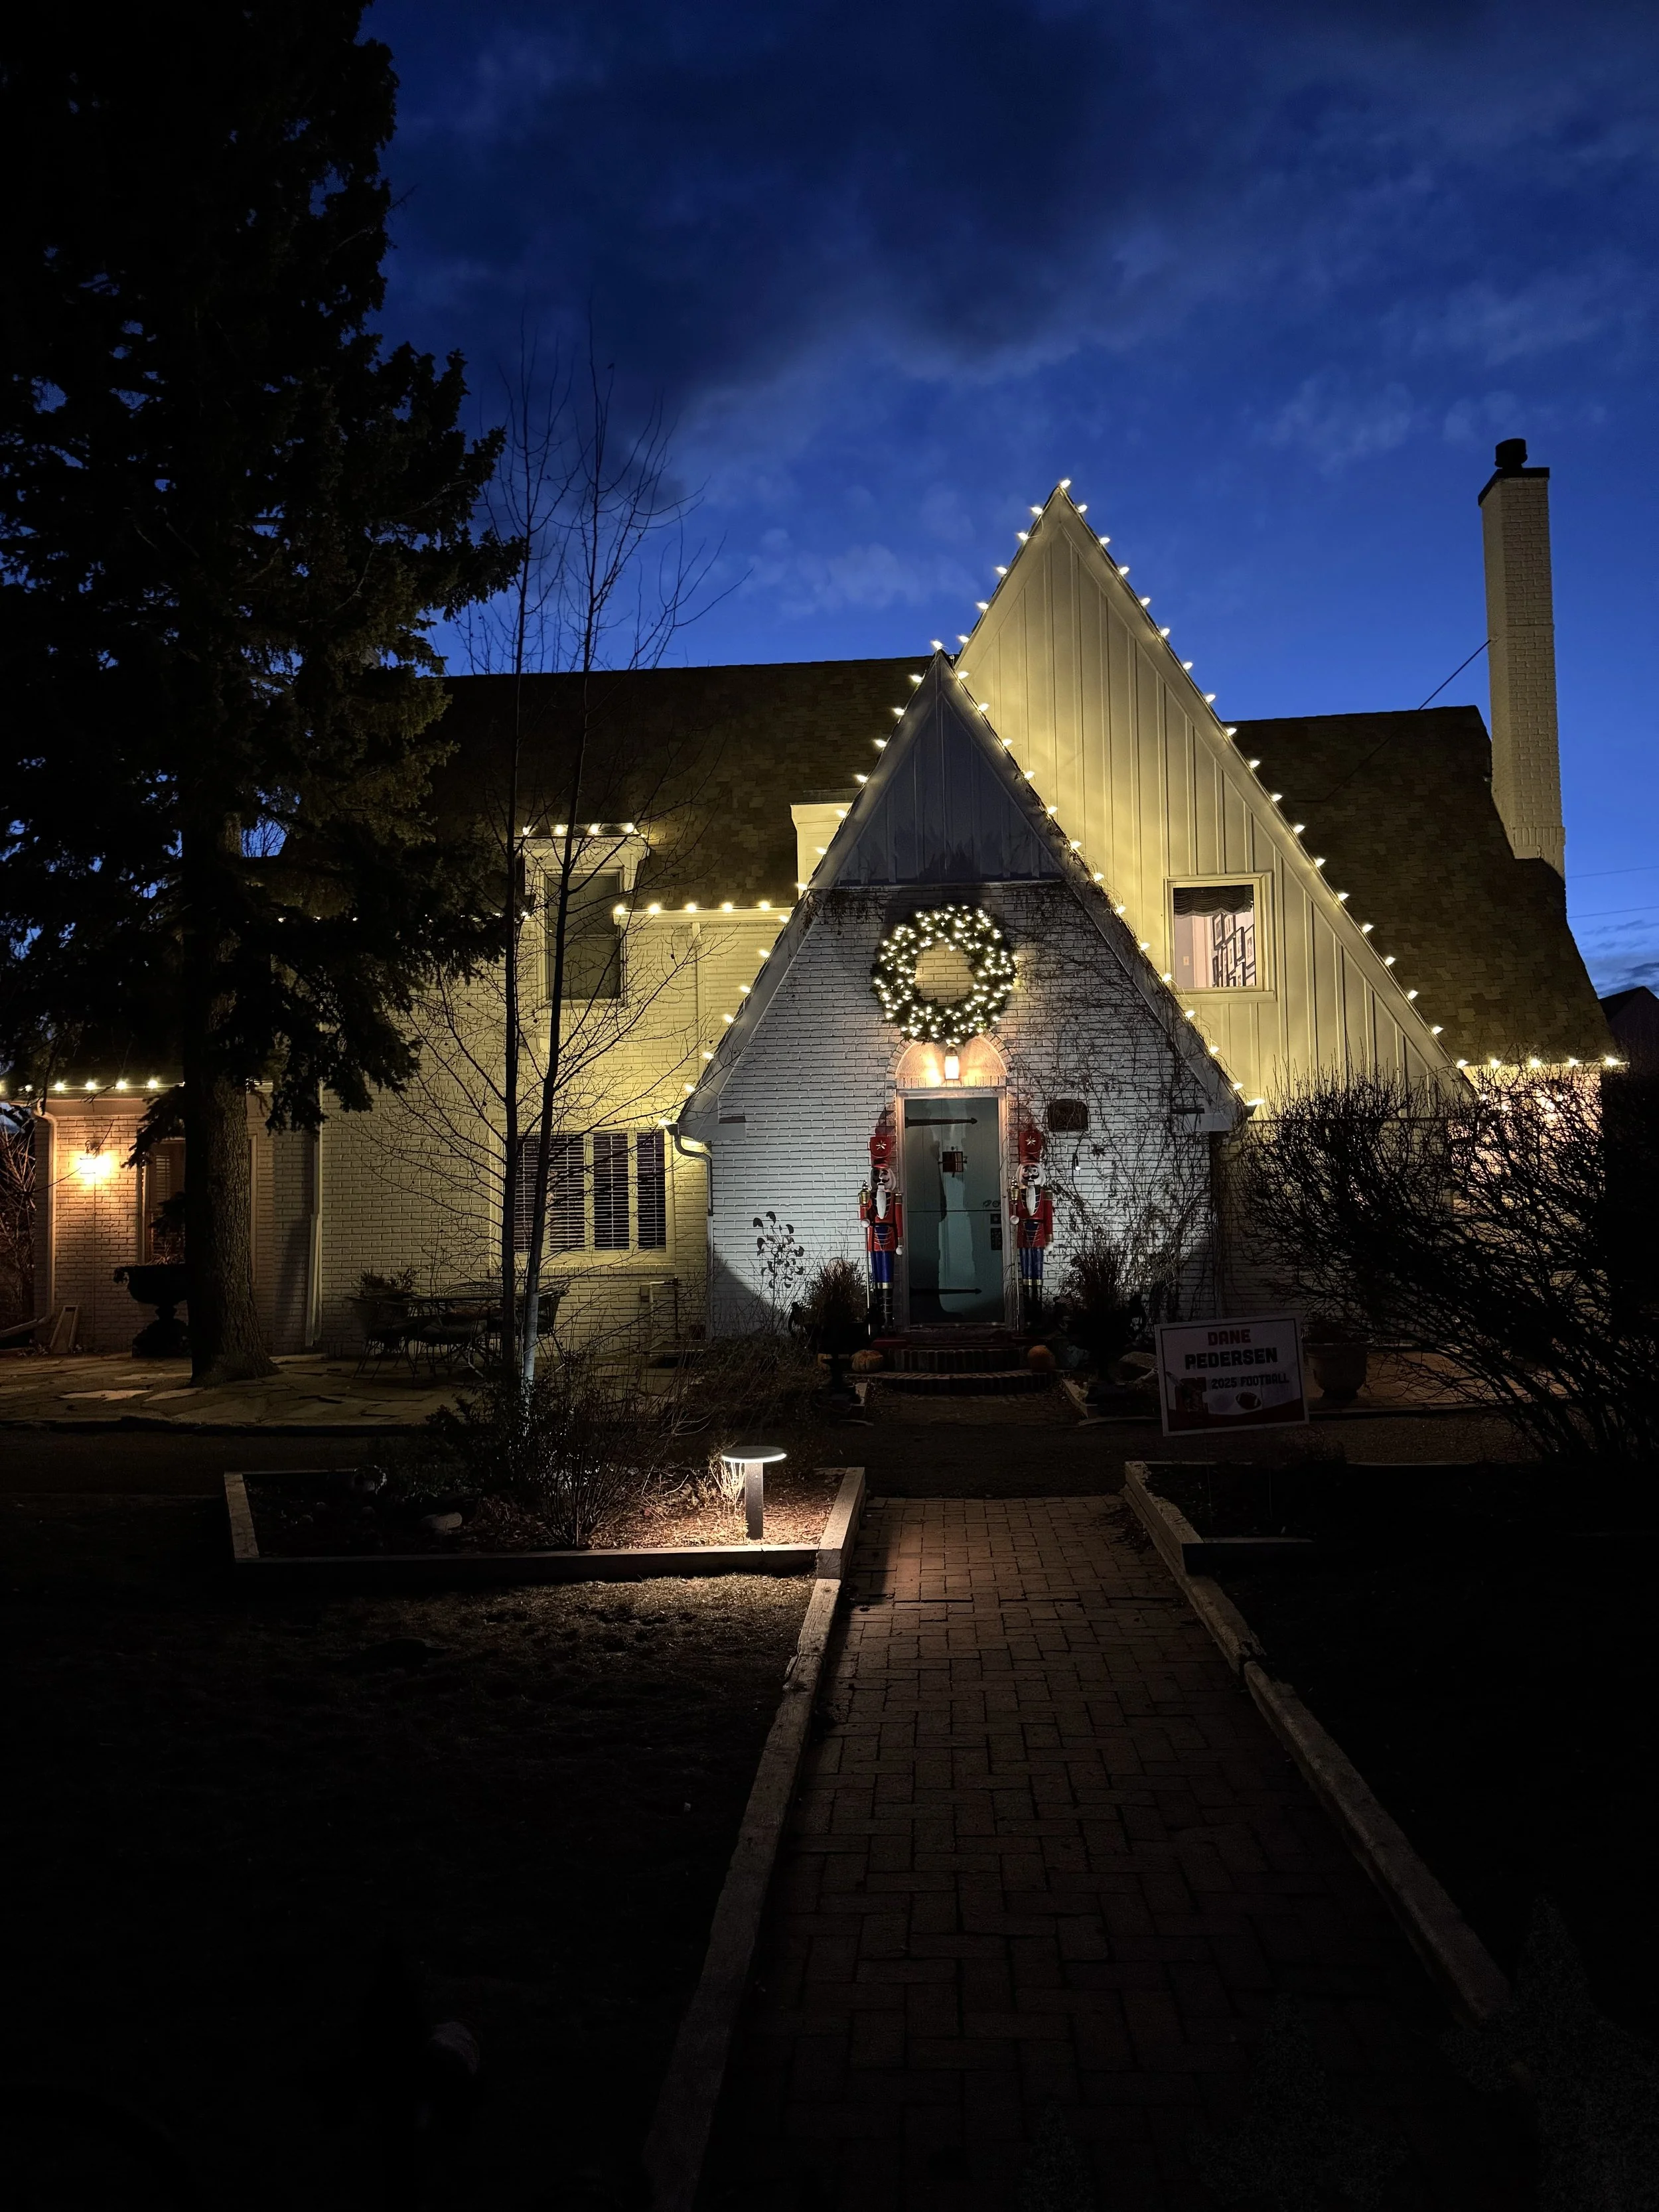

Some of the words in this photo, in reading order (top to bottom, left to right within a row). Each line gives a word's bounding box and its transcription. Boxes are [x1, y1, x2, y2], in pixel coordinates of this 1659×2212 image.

[1208, 1329, 1251, 1345] DANE
[1185, 1348, 1277, 1370] PEDERSEN
[1211, 1377, 1238, 1389] 2025
[1241, 1373, 1289, 1387] FOOTBALL
